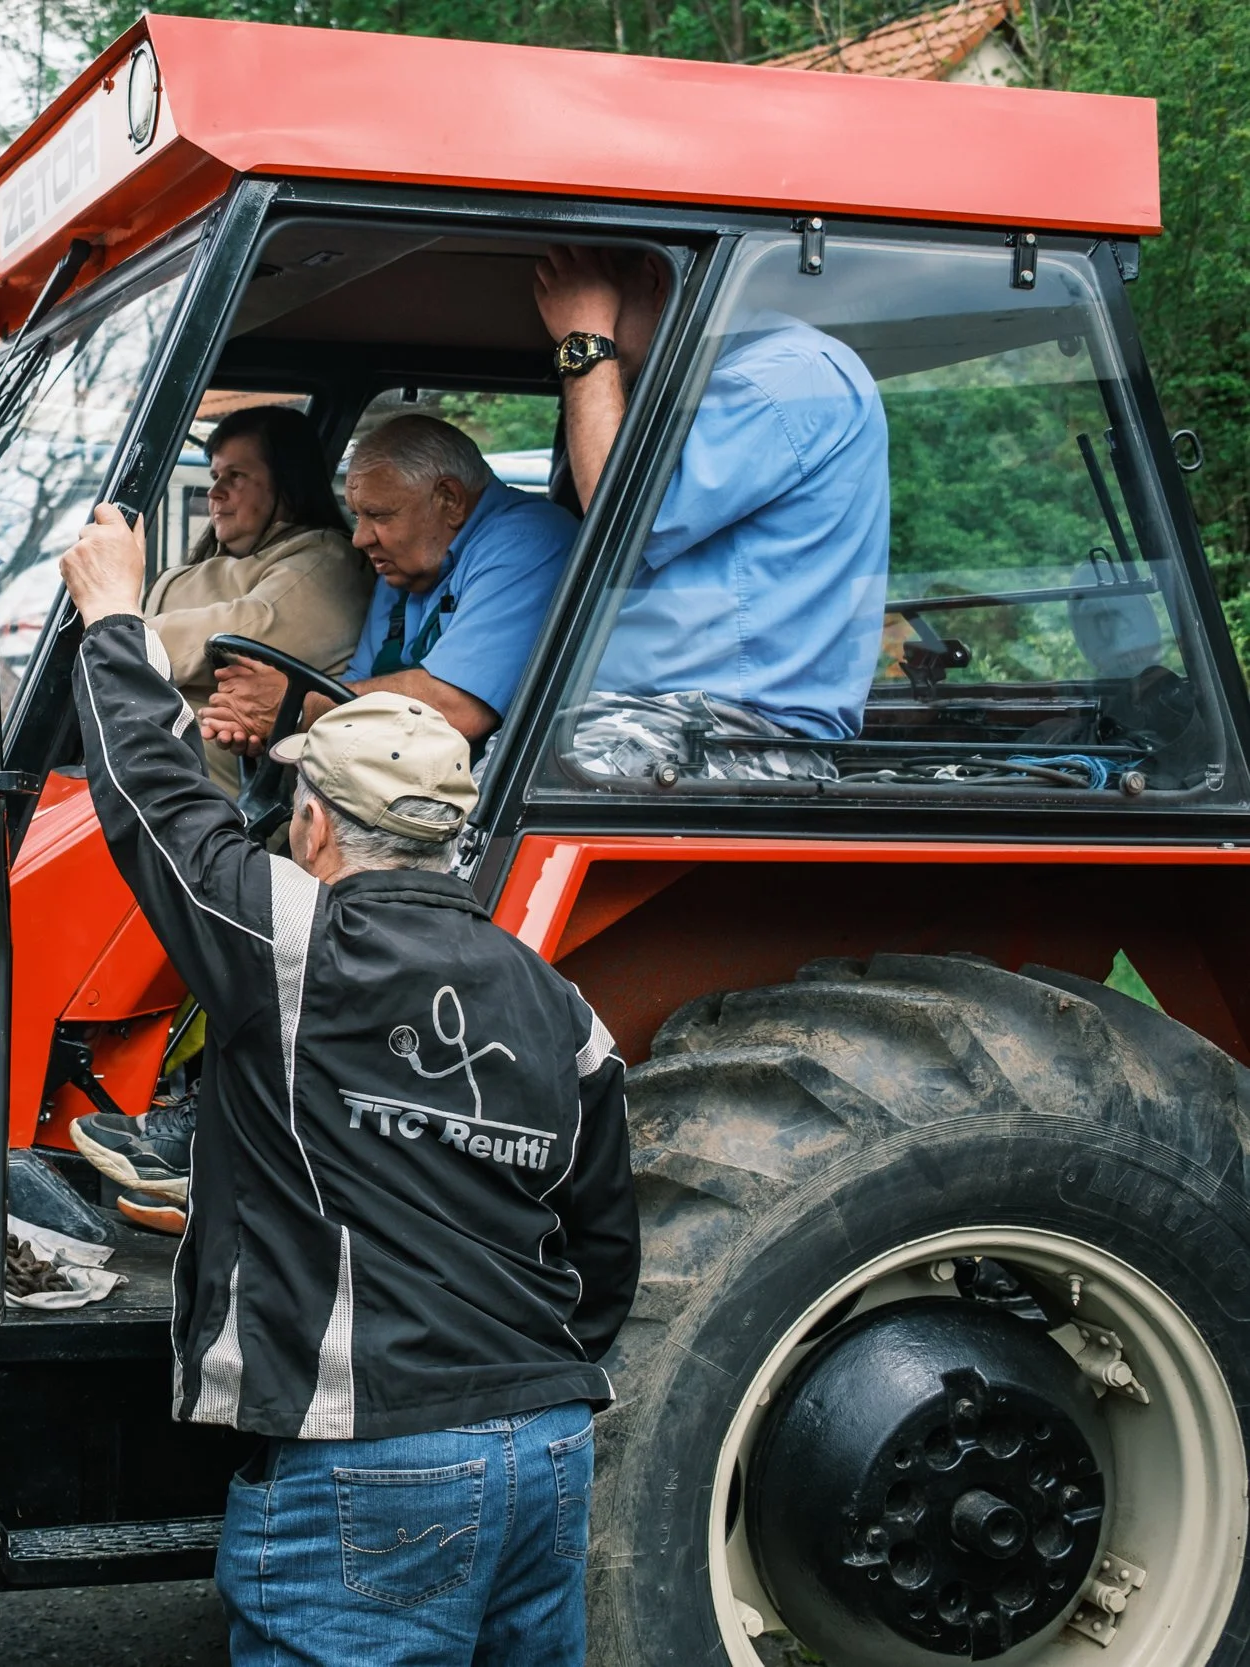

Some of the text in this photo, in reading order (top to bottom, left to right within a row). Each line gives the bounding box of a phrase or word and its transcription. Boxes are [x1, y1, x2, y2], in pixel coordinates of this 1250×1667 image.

[2, 114, 96, 248] ZETOR
[343, 1097, 551, 1171] TTC Reutti
